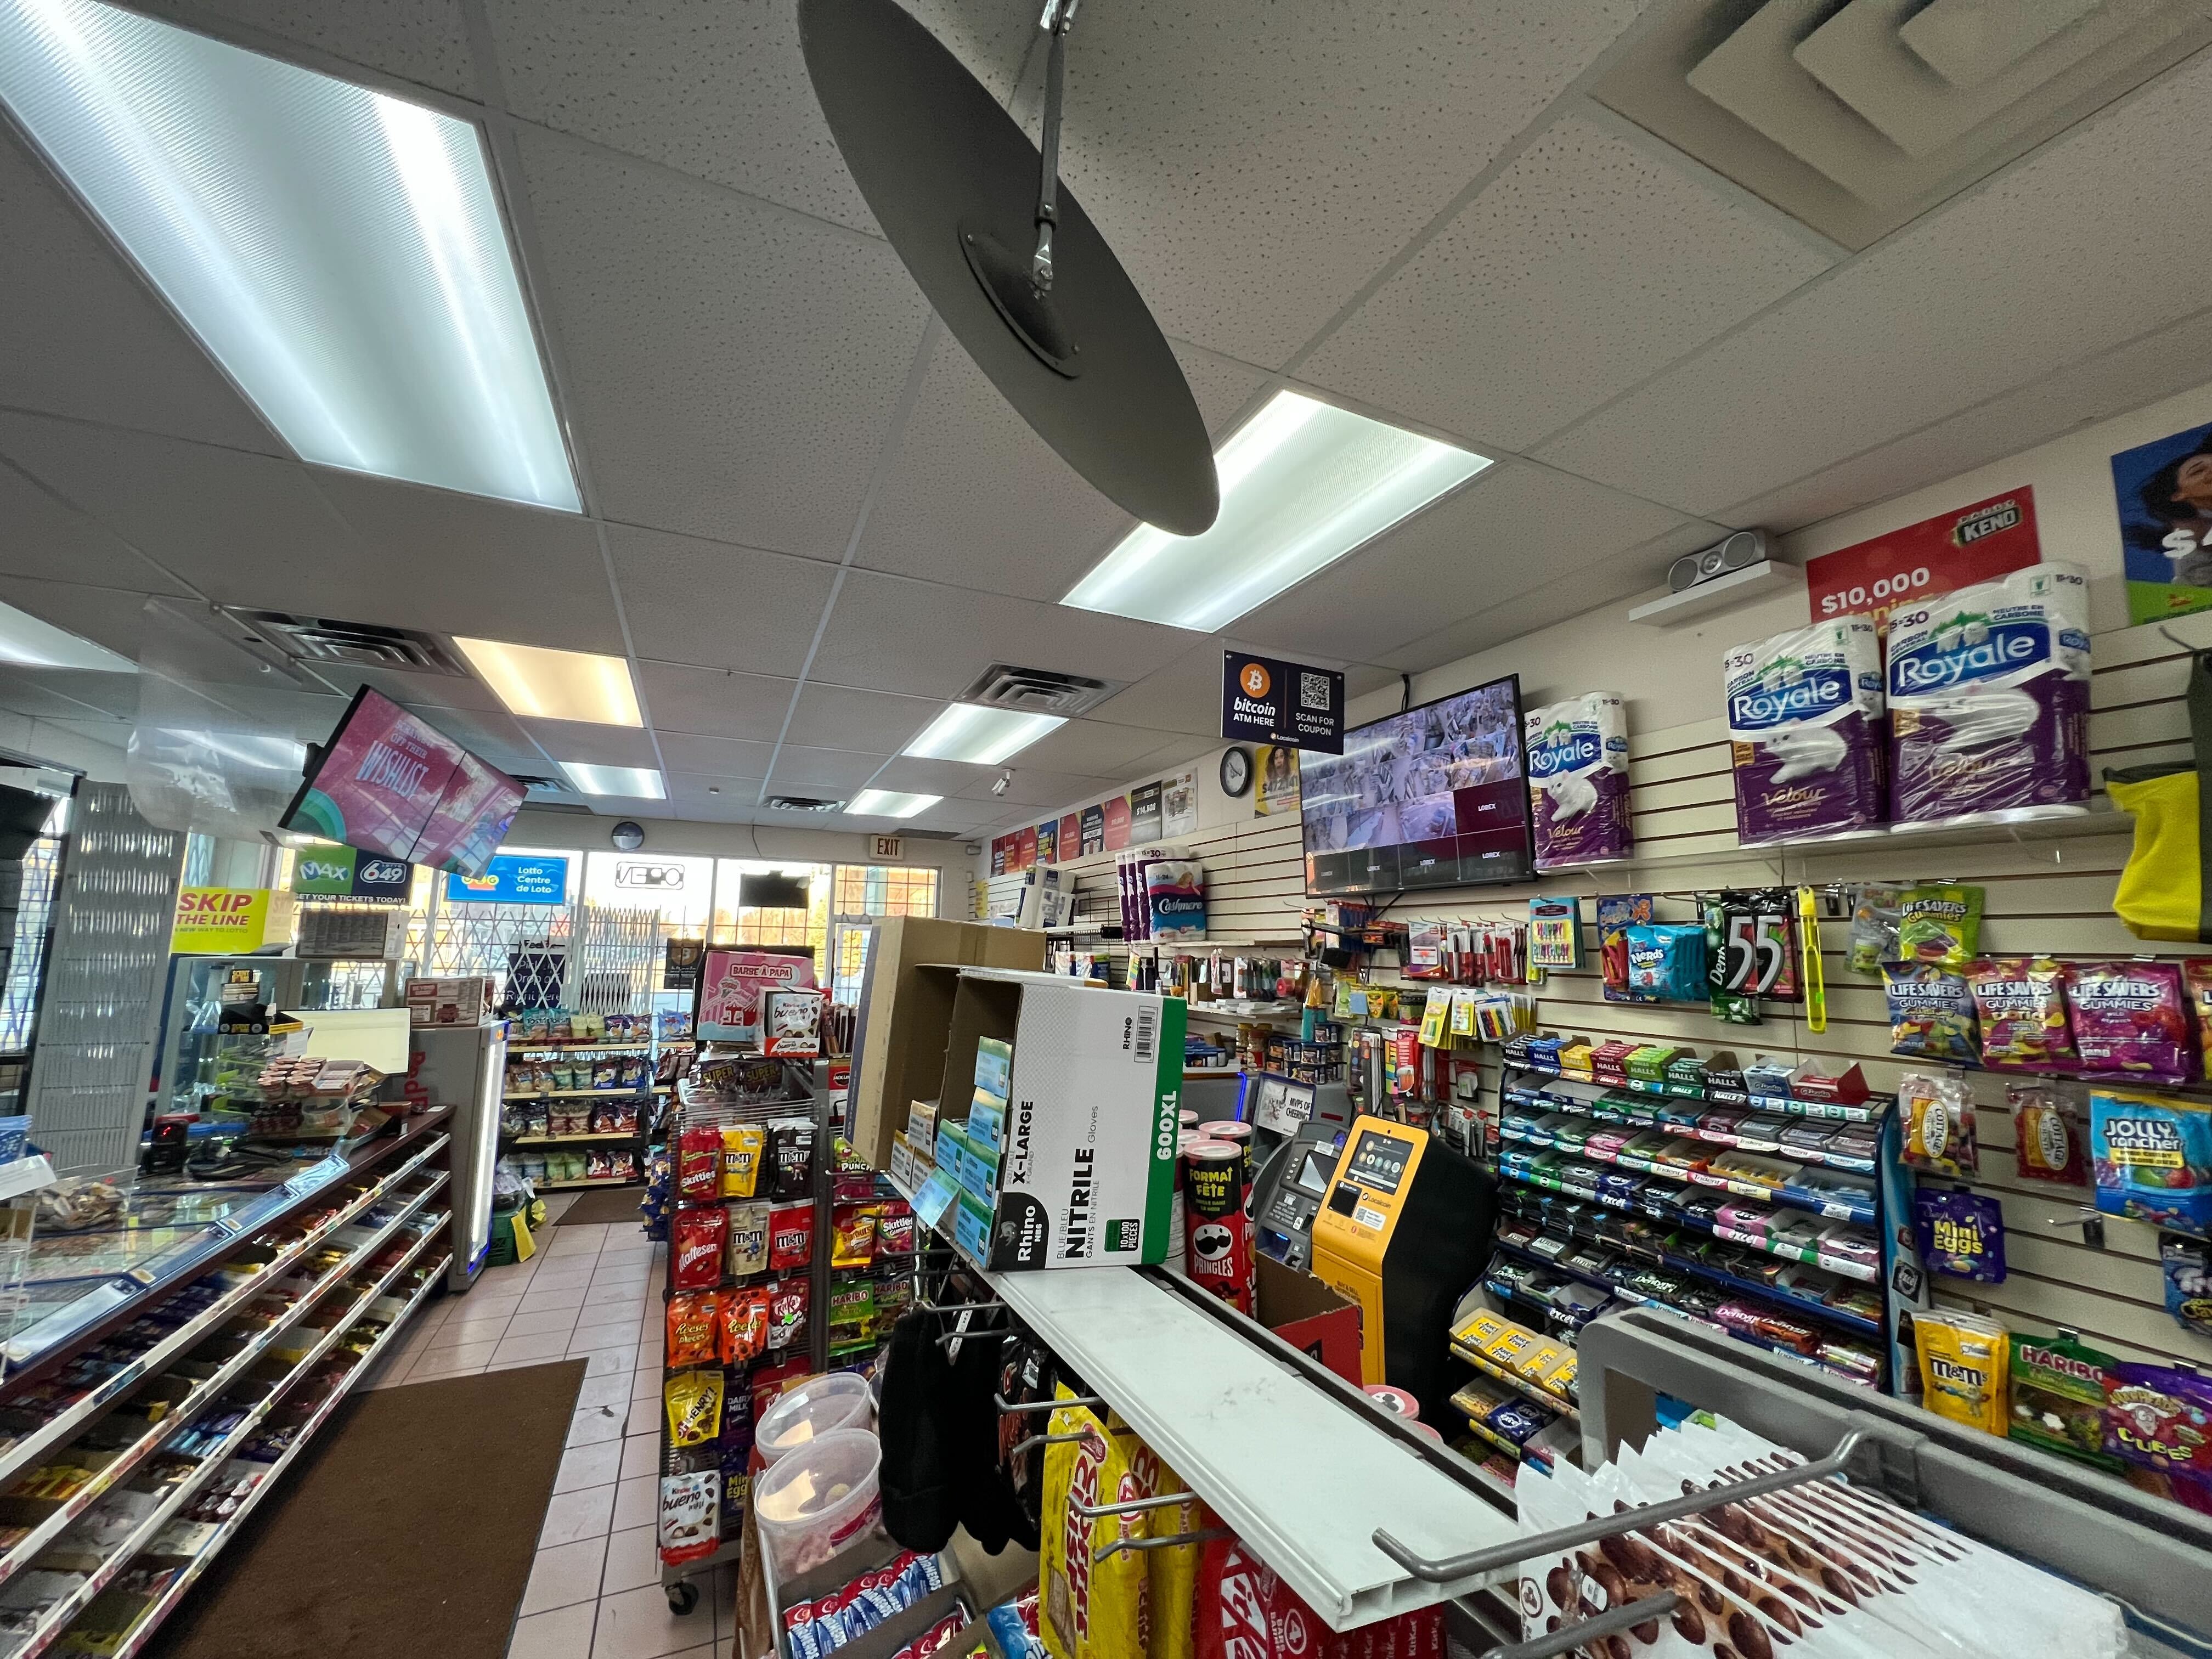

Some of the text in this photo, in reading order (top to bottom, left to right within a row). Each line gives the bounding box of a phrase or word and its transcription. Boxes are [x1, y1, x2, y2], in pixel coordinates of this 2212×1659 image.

[1965, 507, 2016, 541] KENO
[1821, 567, 1930, 614] $10,000
[1899, 633, 2035, 687] Royale
[1234, 697, 1276, 716] bitcoin
[1734, 677, 1839, 722] Royale
[1234, 713, 1274, 727] ATM HERE
[1296, 713, 1334, 726] SCAN FOR
[1298, 724, 1331, 736] COUPON
[1530, 738, 1594, 772] Royale
[356, 740, 429, 801] WISHLIST
[1760, 787, 1826, 806] Velour
[1478, 803, 1496, 812] LOREX
[1547, 824, 1584, 839] Velour
[878, 839, 899, 856] EXIT
[300, 860, 348, 881] MAX
[178, 893, 253, 912] SKIP
[1159, 899, 1203, 915] Cashmere
[177, 914, 250, 926] THE LINE
[1908, 911, 1961, 923] Gummies
[1727, 917, 1754, 989] 5
[1757, 915, 1784, 992] 5
[733, 966, 759, 976] BARBE
[770, 968, 789, 977] PAPA
[1899, 999, 1958, 1010] GUMMIES
[1986, 998, 2047, 1008] GUMMIES
[2080, 1000, 2153, 1011] GUMMIES
[774, 1007, 808, 1019] bueno
[1122, 1017, 1132, 1050] RHINO
[1505, 1048, 1525, 1057] HALLS
[1534, 1053, 1555, 1062] HALLS
[1597, 1063, 1621, 1071] HALLS
[1630, 1067, 1655, 1075] HALLS
[1668, 1072, 1696, 1081] HALLS
[1708, 1077, 1739, 1087] HALLS
[1714, 1092, 1737, 1101] HALLS
[1156, 1091, 1176, 1160] 600XL
[1934, 1108, 1944, 1156] COTTAGE
[2106, 1120, 2174, 1138] JOLLY
[1012, 1101, 1033, 1184] X-LARGE
[2050, 1116, 2065, 1164] COTTAGE
[2112, 1137, 2179, 1150] rancher
[1026, 1151, 1035, 1184] X-GRAND
[1189, 1166, 1233, 1182] FORMAT
[1656, 1165, 1680, 1176] Trident
[681, 1171, 715, 1188] Skittles
[1065, 1105, 1098, 1259] NITRILE Gloves
[1694, 1173, 1720, 1186] Trident
[1197, 1182, 1224, 1198] FÊTE
[1369, 1194, 1391, 1209] Localcoin
[1601, 1195, 1627, 1207] excel
[1086, 1180, 1099, 1259] GANTS EN NITRILE
[1018, 1205, 1036, 1262] Rhino
[1057, 1209, 1069, 1259] BLUE/BLEU
[1120, 1221, 1130, 1248] 10x100
[1128, 1222, 1138, 1248] PIECES
[1934, 1220, 1978, 1242] Mini
[1934, 1234, 1983, 1255] Eggs
[1194, 1254, 1233, 1277] PRINGLES
[873, 1280, 908, 1293] HARIBO
[832, 1290, 868, 1306] HARIBO
[1549, 1308, 1576, 1324] excel
[2021, 1345, 2103, 1384] HARIBO
[727, 1395, 752, 1405] DAIRY
[729, 1403, 748, 1413] MILK
[2117, 1427, 2193, 1461] CUBES
[728, 1475, 747, 1485] Min
[726, 1485, 747, 1499] Egg
[663, 1491, 701, 1512] bueno
[1408, 1618, 1417, 1657] KitKat
